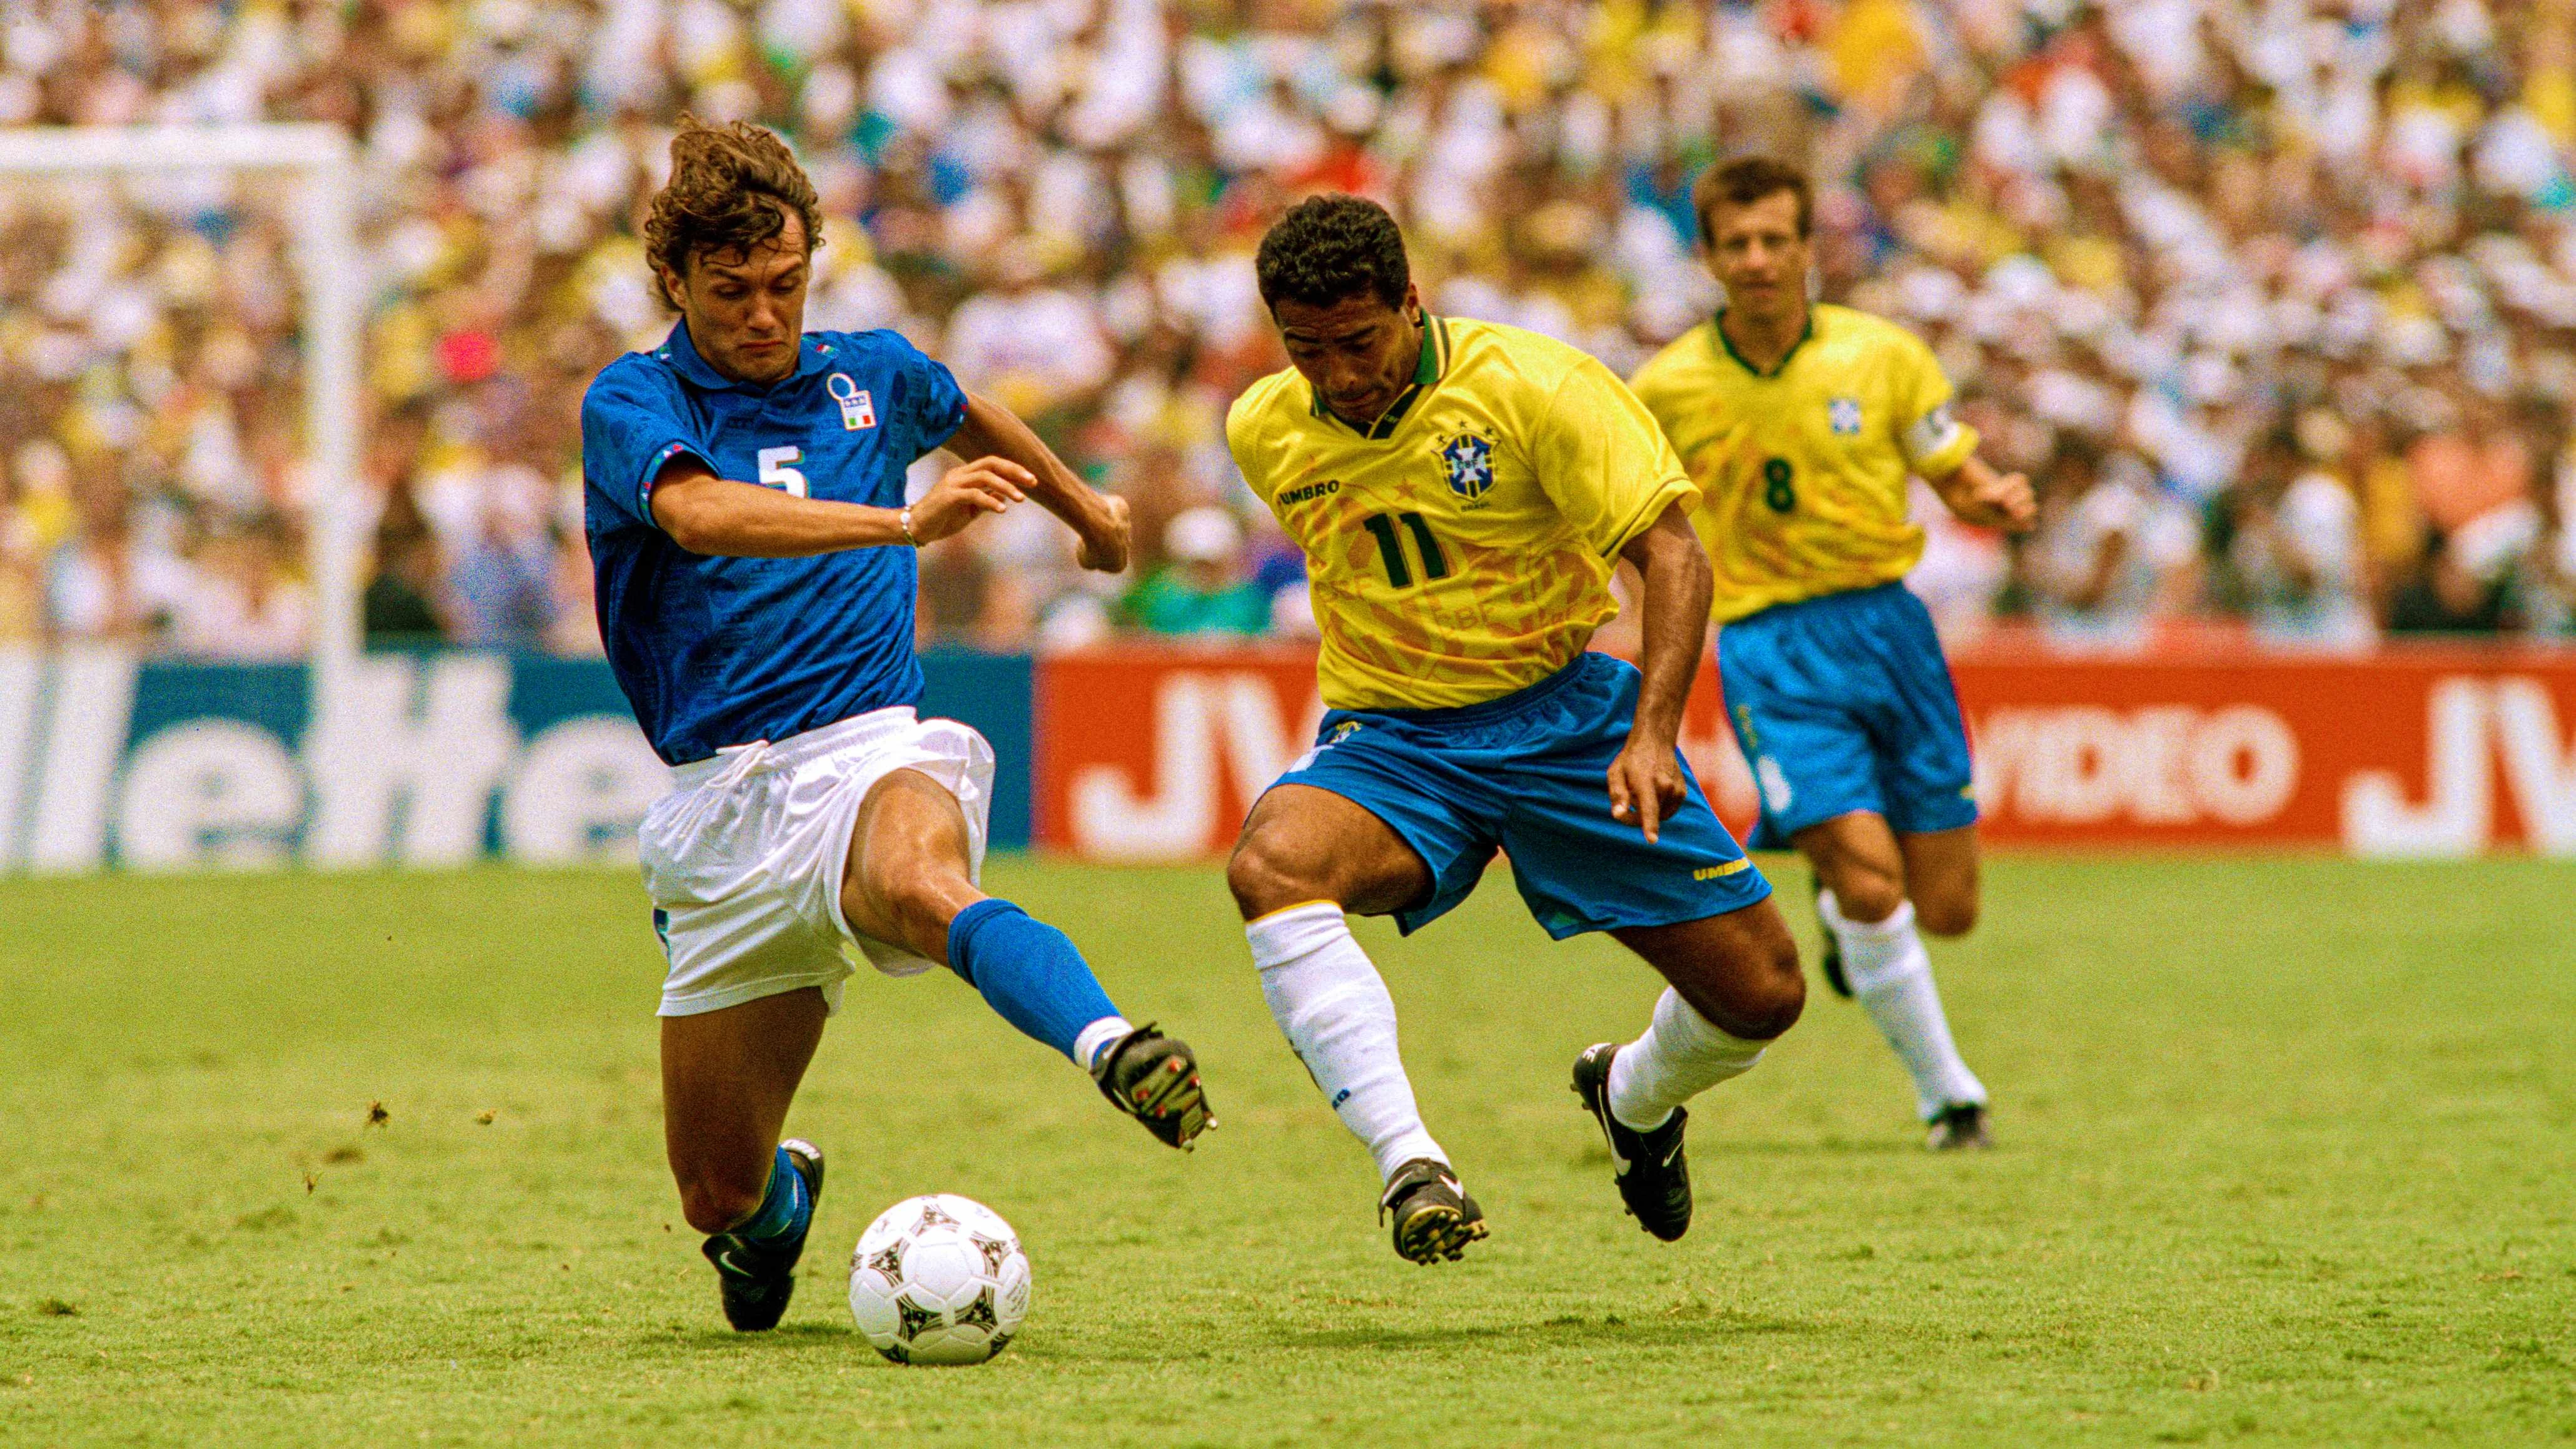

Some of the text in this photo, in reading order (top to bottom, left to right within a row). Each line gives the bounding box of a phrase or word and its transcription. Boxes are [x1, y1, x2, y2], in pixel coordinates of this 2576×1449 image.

[758, 445, 811, 499] 5
[1279, 479, 1339, 505] UMBRO
[1763, 457, 1795, 514] 8
[1363, 512, 1451, 589] 11
